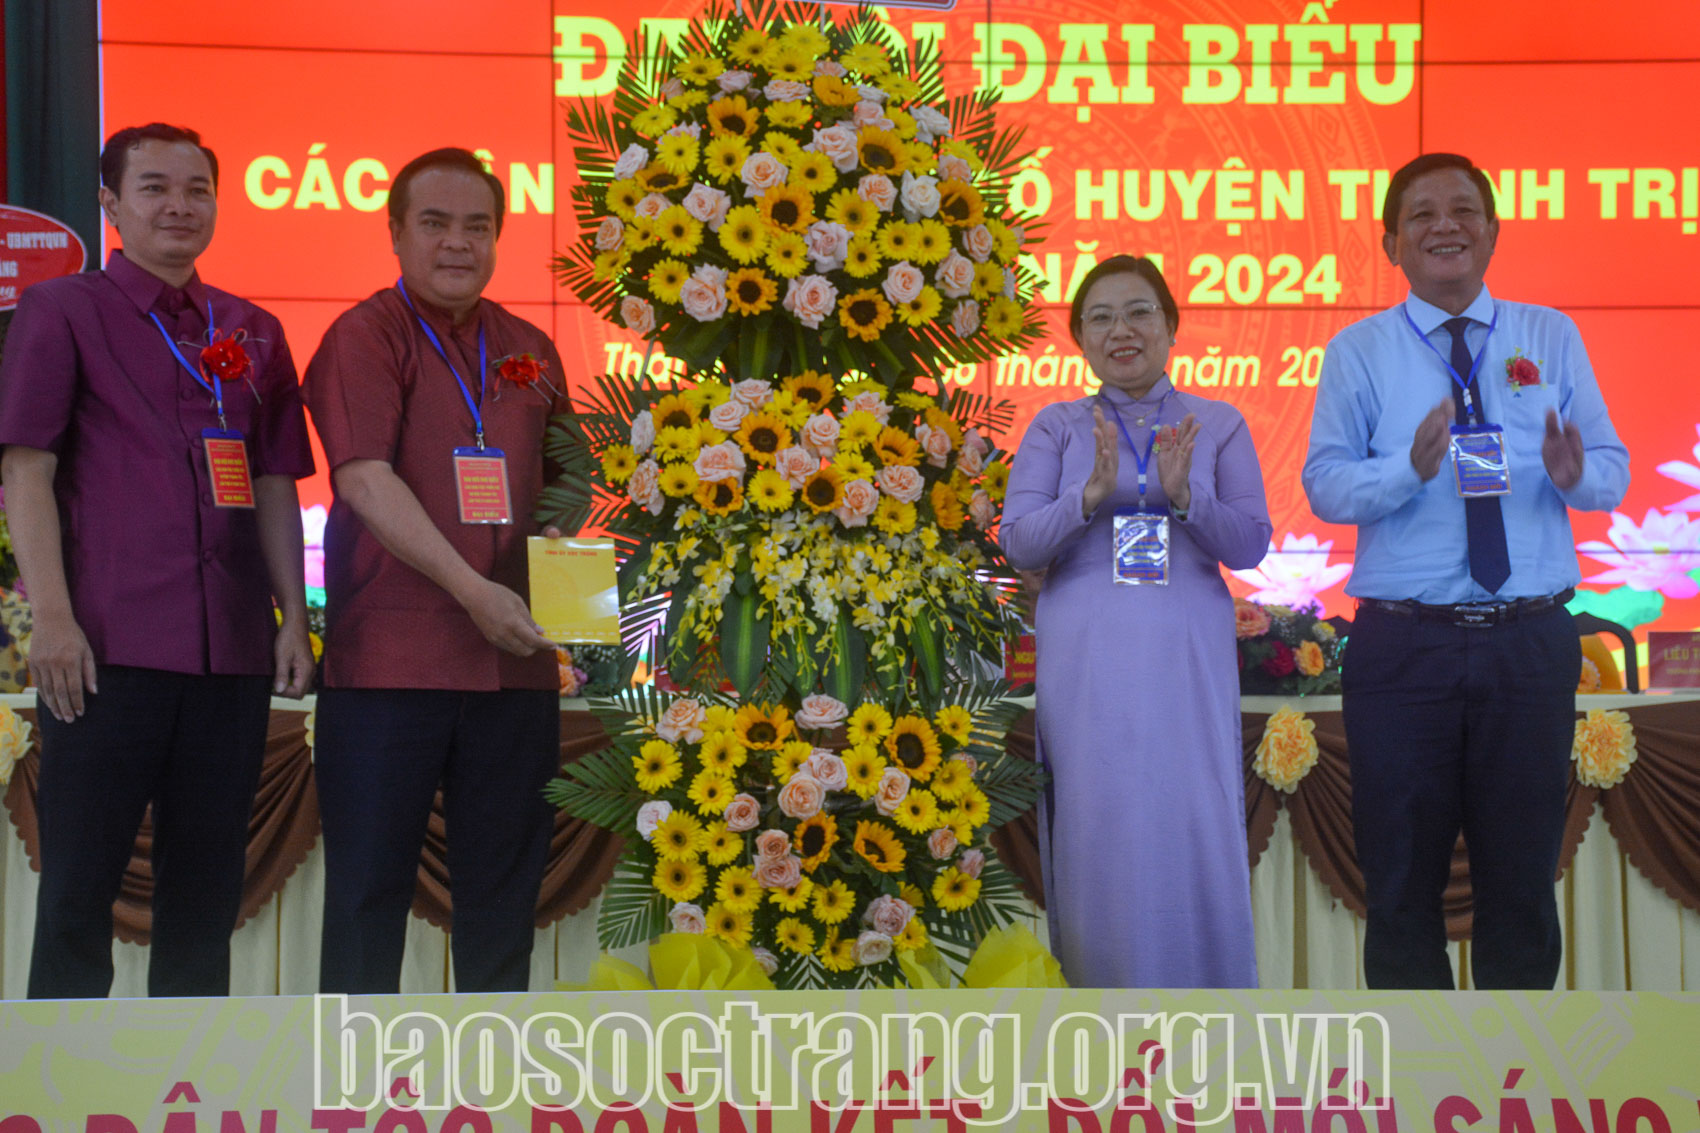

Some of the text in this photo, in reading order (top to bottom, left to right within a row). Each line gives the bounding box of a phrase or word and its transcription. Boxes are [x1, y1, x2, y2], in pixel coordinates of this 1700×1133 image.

[971, 22, 1155, 123] ĐẠI
[1182, 0, 1422, 105] BIỂU
[244, 143, 390, 212] CÁC
[1074, 156, 1305, 236] HUYỆN
[1588, 167, 1699, 235] TRỊ
[1188, 254, 1342, 305] 2024
[1169, 345, 1261, 388] năm
